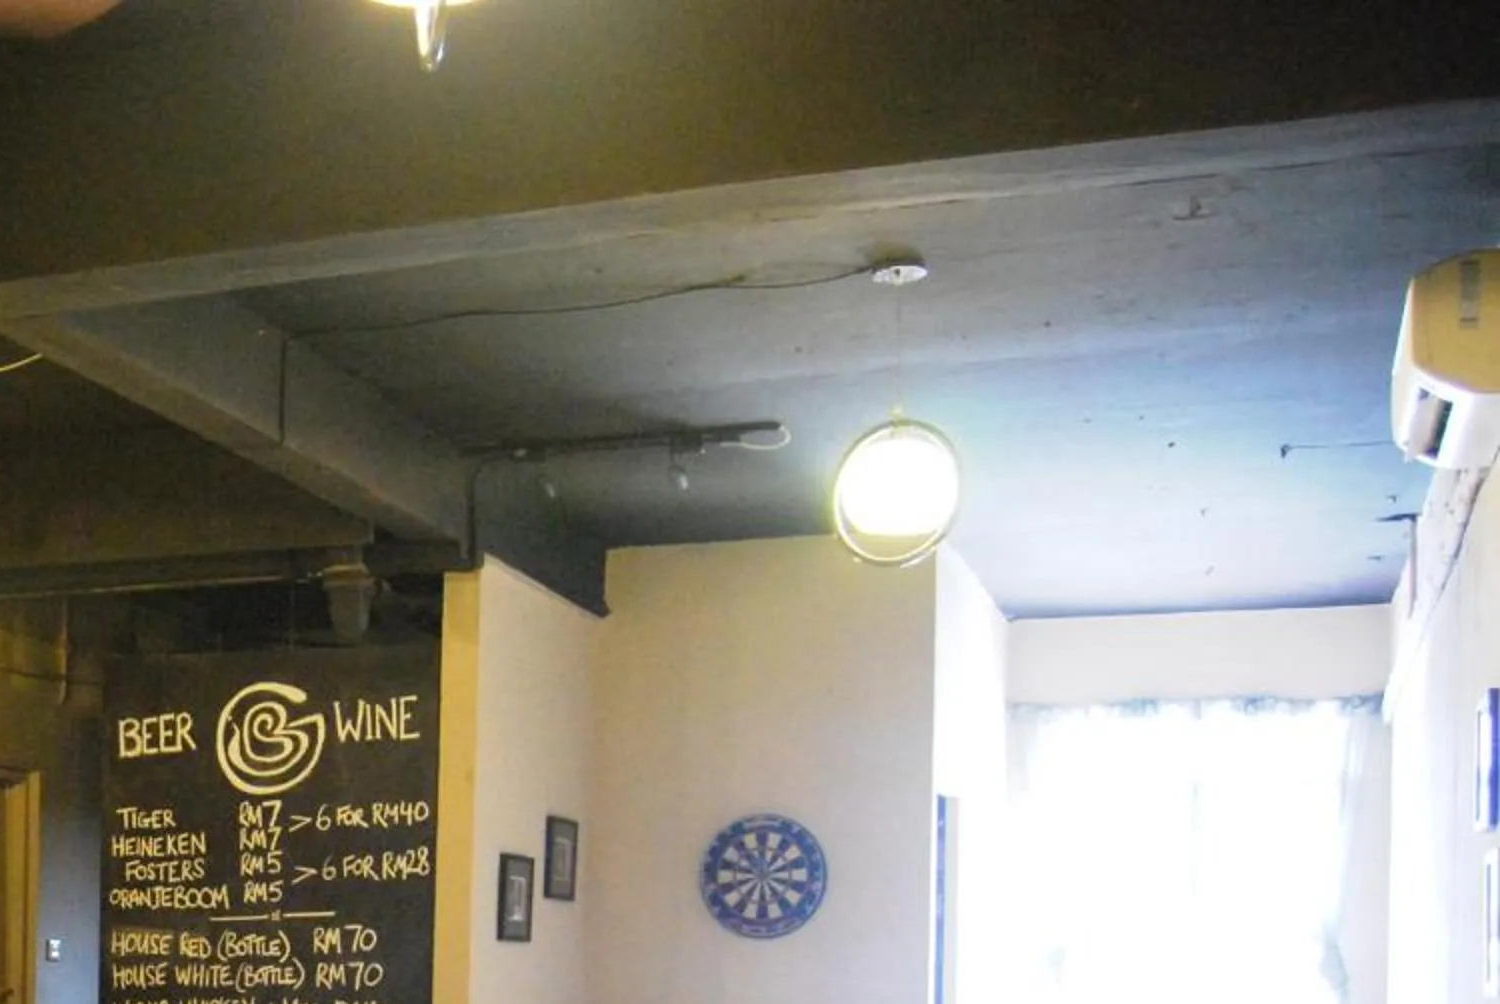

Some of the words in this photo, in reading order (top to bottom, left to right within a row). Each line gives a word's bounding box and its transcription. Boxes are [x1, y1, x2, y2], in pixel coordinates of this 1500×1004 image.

[118, 711, 197, 758] BEER
[333, 695, 421, 743] WINE
[116, 807, 176, 829] TIGER
[239, 800, 282, 827] RM7
[336, 806, 368, 828] FOR
[372, 801, 429, 826] RM40
[112, 831, 206, 858] HEINEKEN
[239, 828, 283, 851] RM7
[125, 858, 205, 882] FOSTERS
[239, 852, 283, 877] RM5
[342, 854, 378, 881] FOR
[381, 846, 430, 880] RM28
[109, 887, 230, 910] ORANJEBOOM
[243, 880, 284, 904] RM5
[112, 930, 171, 956] HOUSE
[180, 931, 211, 959] RED
[217, 930, 291, 963] (BOTTLE)
[112, 962, 167, 989] HOUSE
[175, 962, 234, 987] WHITE
[236, 959, 306, 993] (BOTTLE)
